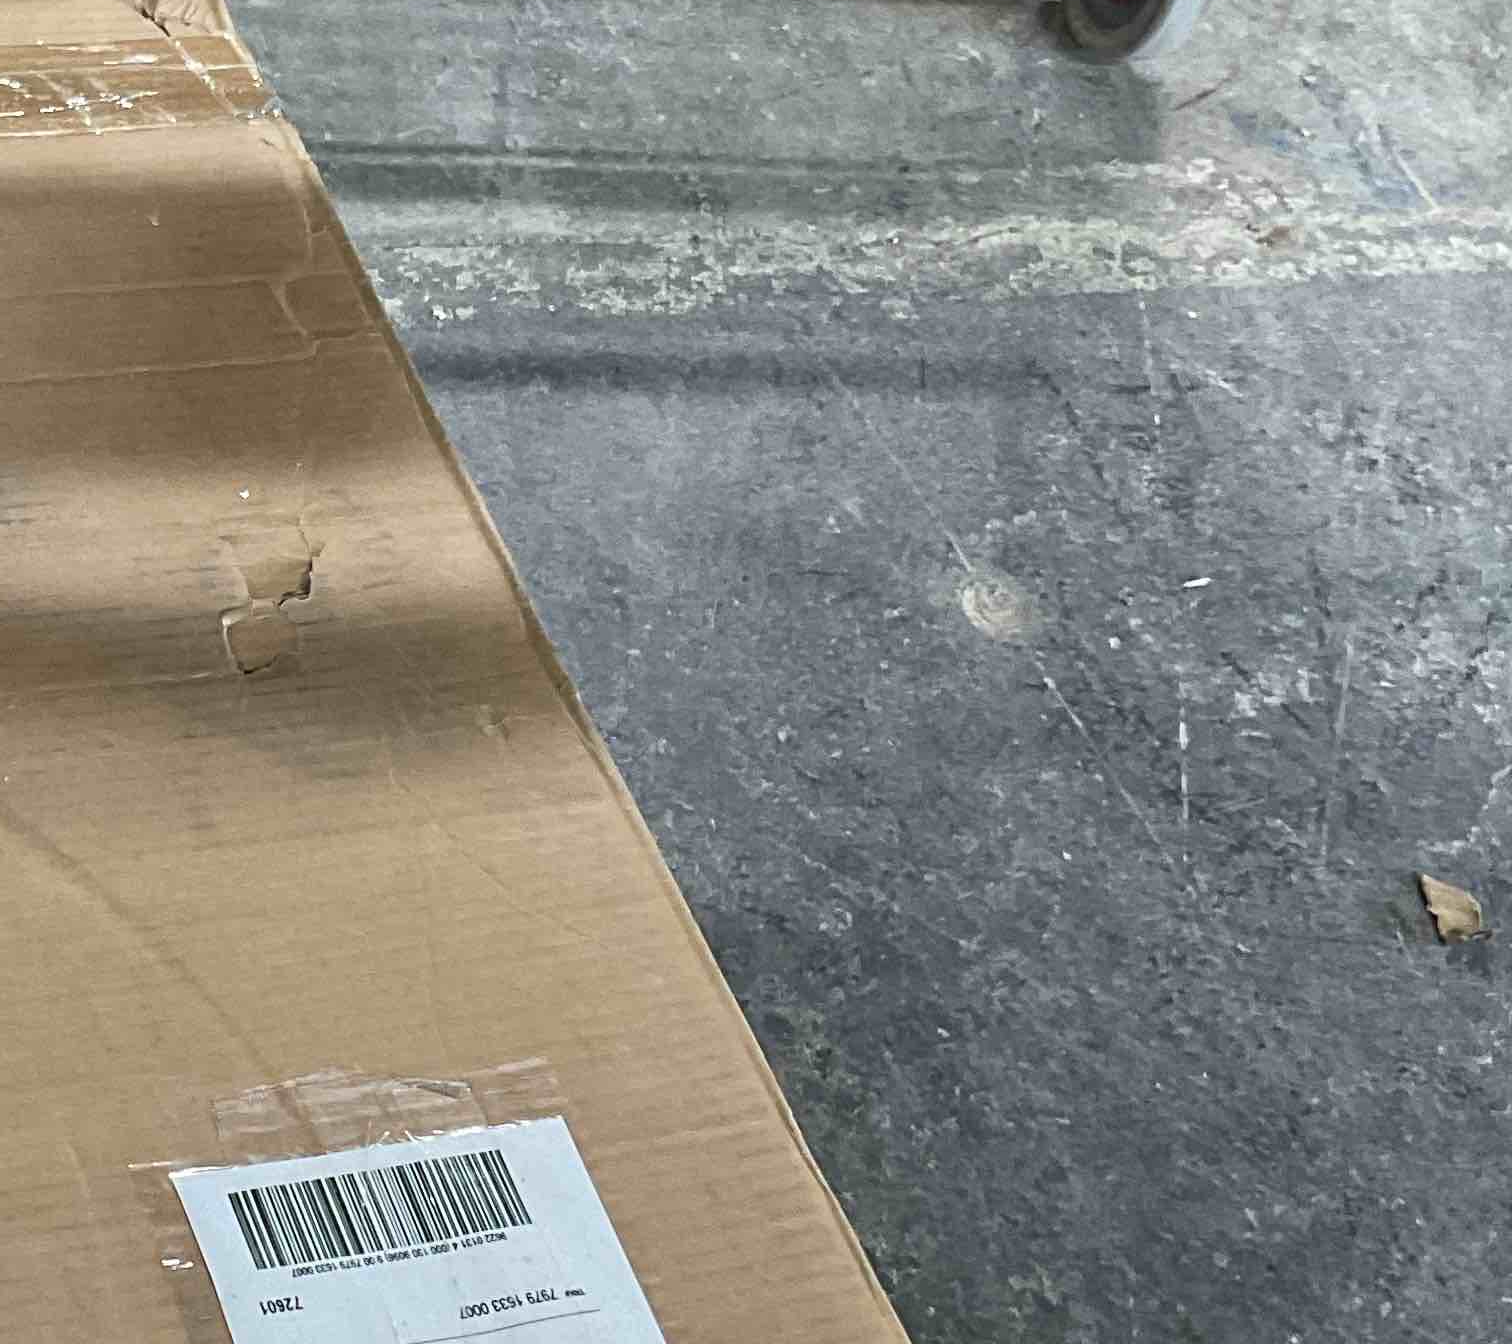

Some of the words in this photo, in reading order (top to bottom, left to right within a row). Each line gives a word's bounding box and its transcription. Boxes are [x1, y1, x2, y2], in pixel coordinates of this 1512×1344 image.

[258, 1294, 304, 1316] 72601
[525, 1287, 559, 1308] 7979
[459, 1300, 489, 1319] 0007
